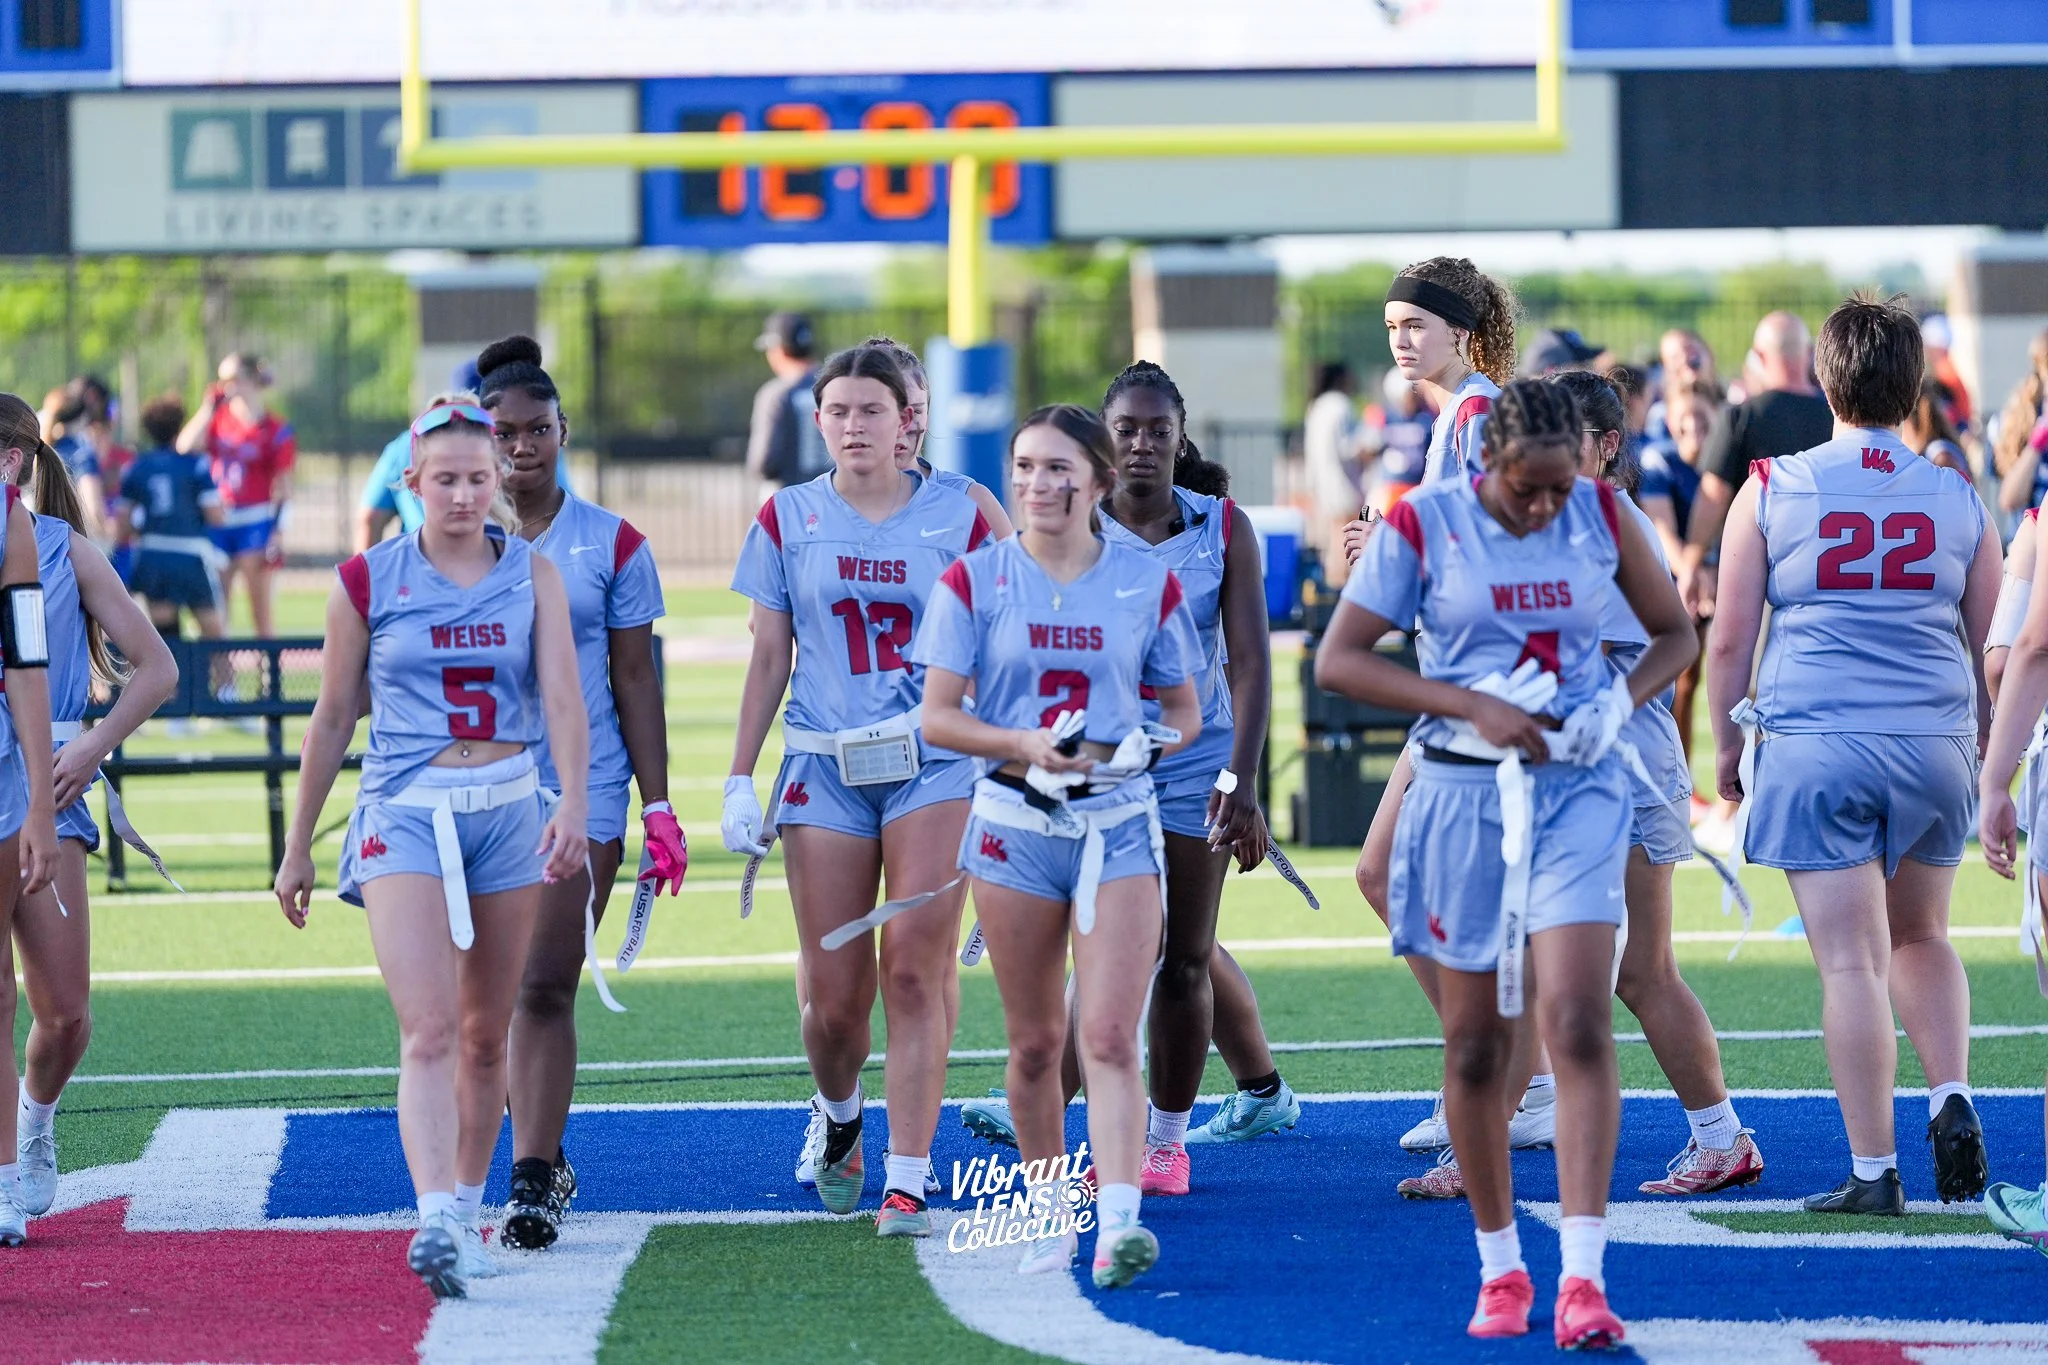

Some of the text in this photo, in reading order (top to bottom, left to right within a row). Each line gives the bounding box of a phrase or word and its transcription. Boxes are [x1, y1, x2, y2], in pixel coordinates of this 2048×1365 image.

[837, 555, 907, 584] WEISS
[1816, 511, 1936, 590] 22
[1490, 580, 1573, 613] WEISS
[430, 623, 507, 649] WEISS
[831, 597, 914, 676] 12
[1028, 622, 1104, 651] WEISS
[442, 666, 497, 740] 5
[1038, 669, 1091, 730] 2
